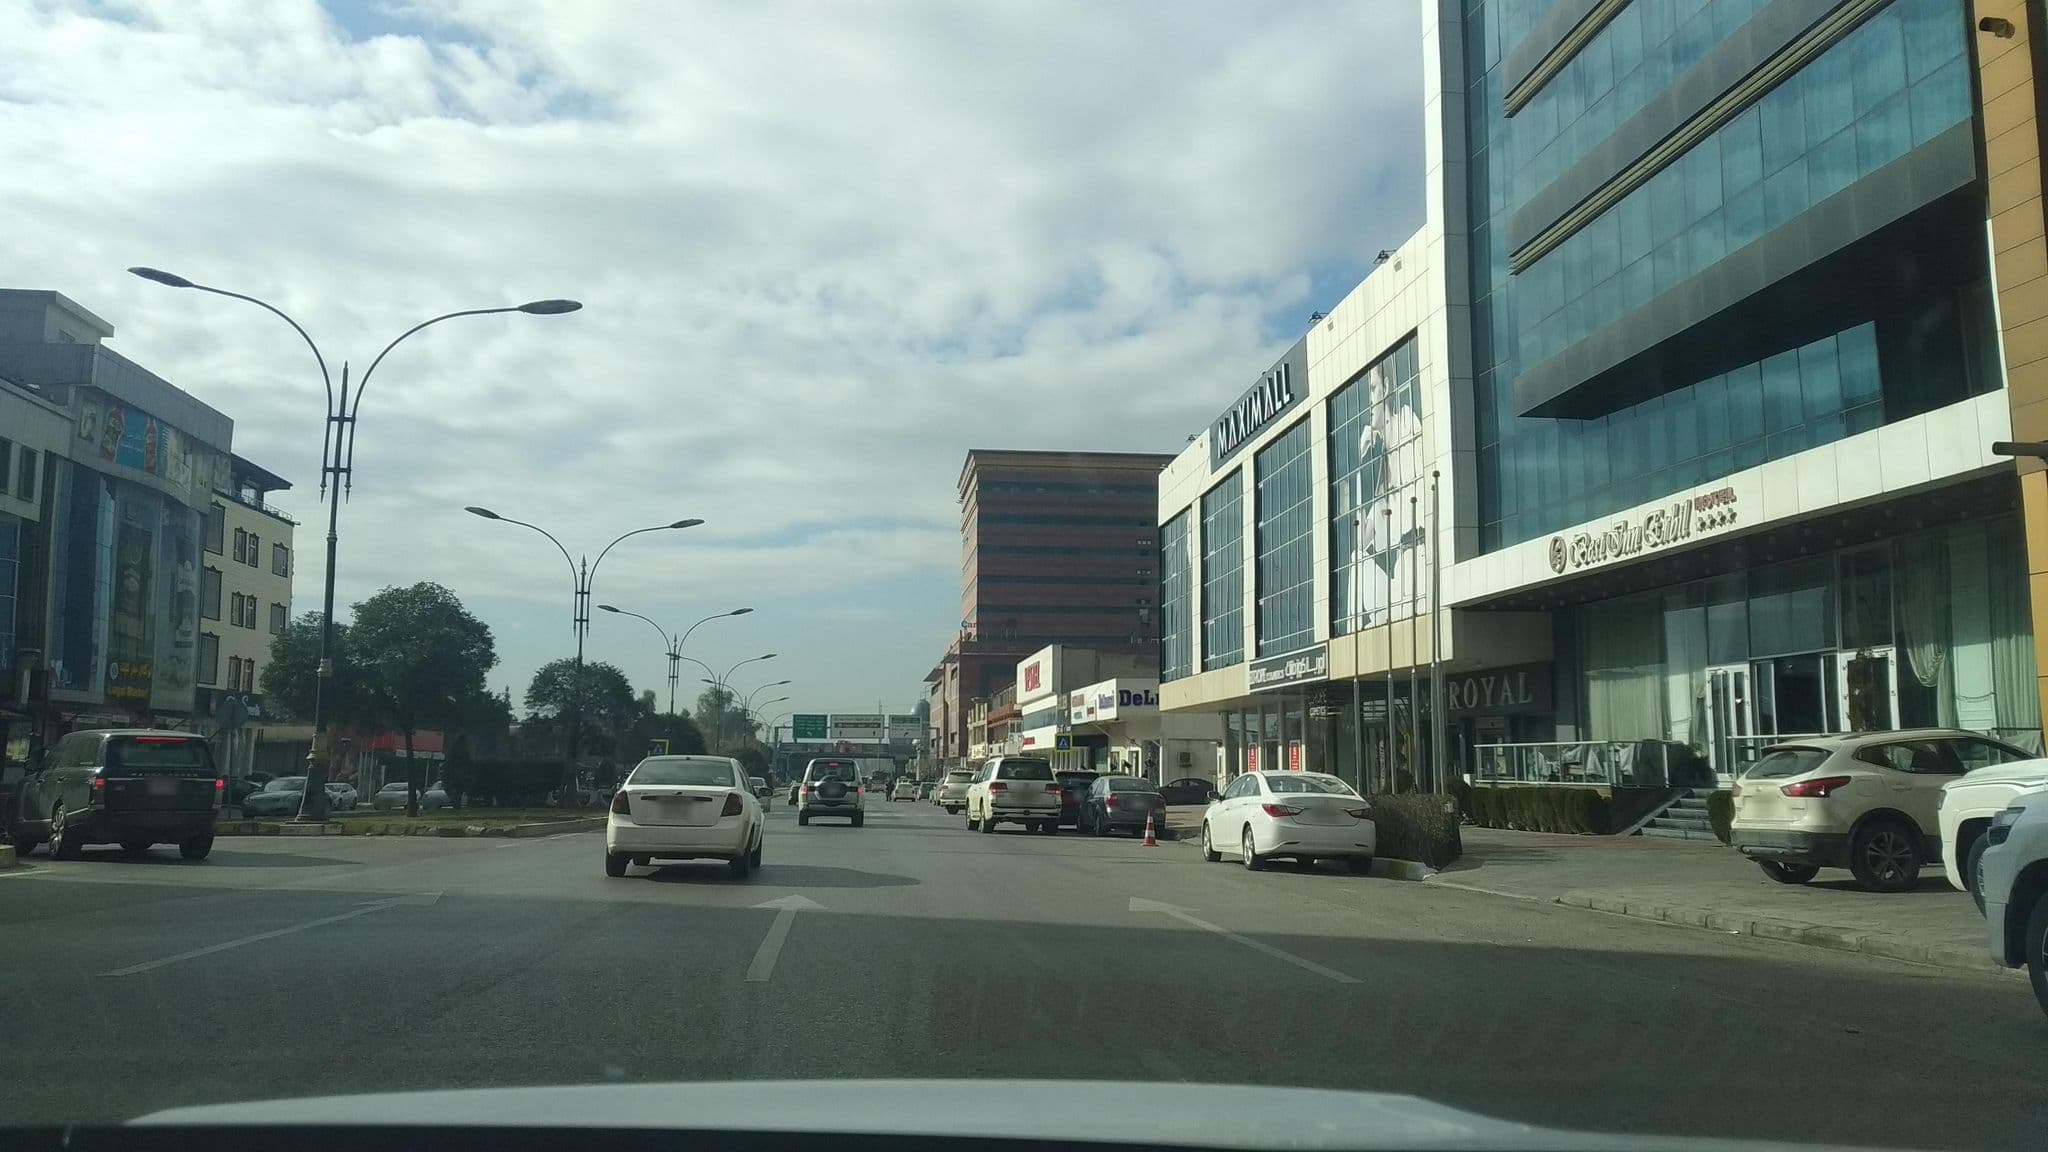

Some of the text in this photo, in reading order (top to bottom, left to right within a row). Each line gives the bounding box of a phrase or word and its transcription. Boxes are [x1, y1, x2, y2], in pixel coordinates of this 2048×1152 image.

[1217, 363, 1293, 459] MAXIMALL
[1694, 487, 1738, 513] HOTEL
[1448, 672, 1533, 710] ROYAL
